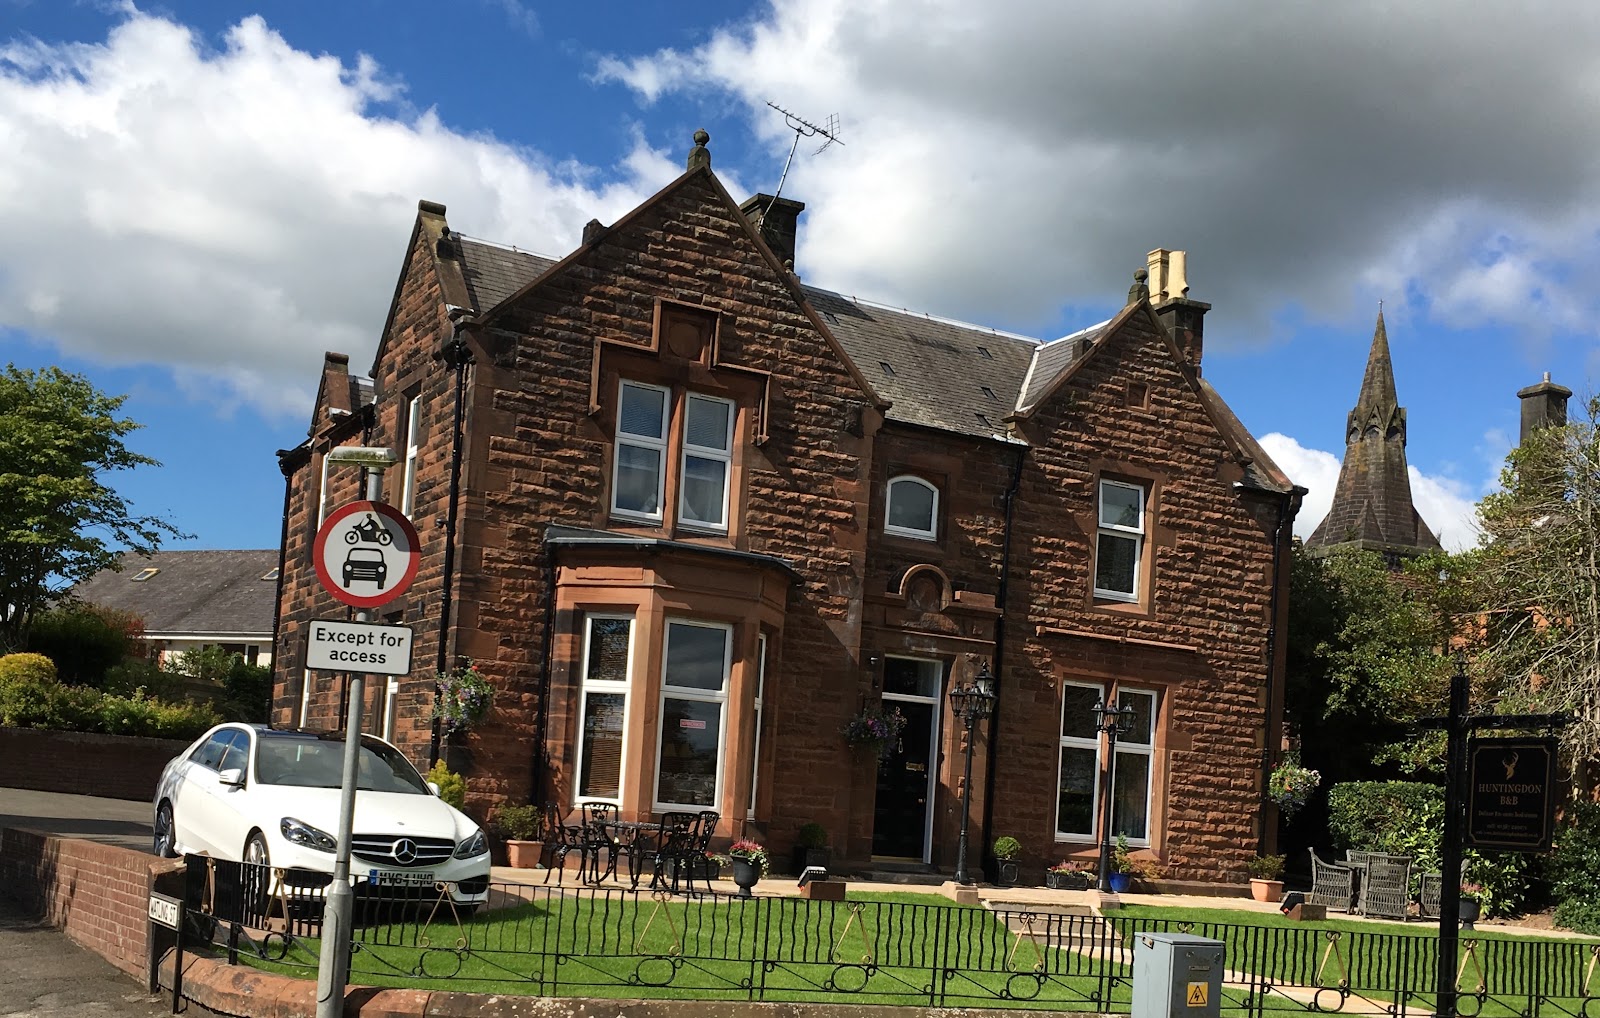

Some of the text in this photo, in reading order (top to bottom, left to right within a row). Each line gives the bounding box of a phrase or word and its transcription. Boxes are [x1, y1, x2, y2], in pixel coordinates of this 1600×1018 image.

[316, 627, 404, 647] Except for
[329, 650, 387, 664] access
[1478, 783, 1542, 794] HUNTINGDON
[1500, 796, 1519, 805] B&B
[150, 898, 177, 924] WATLING ST
